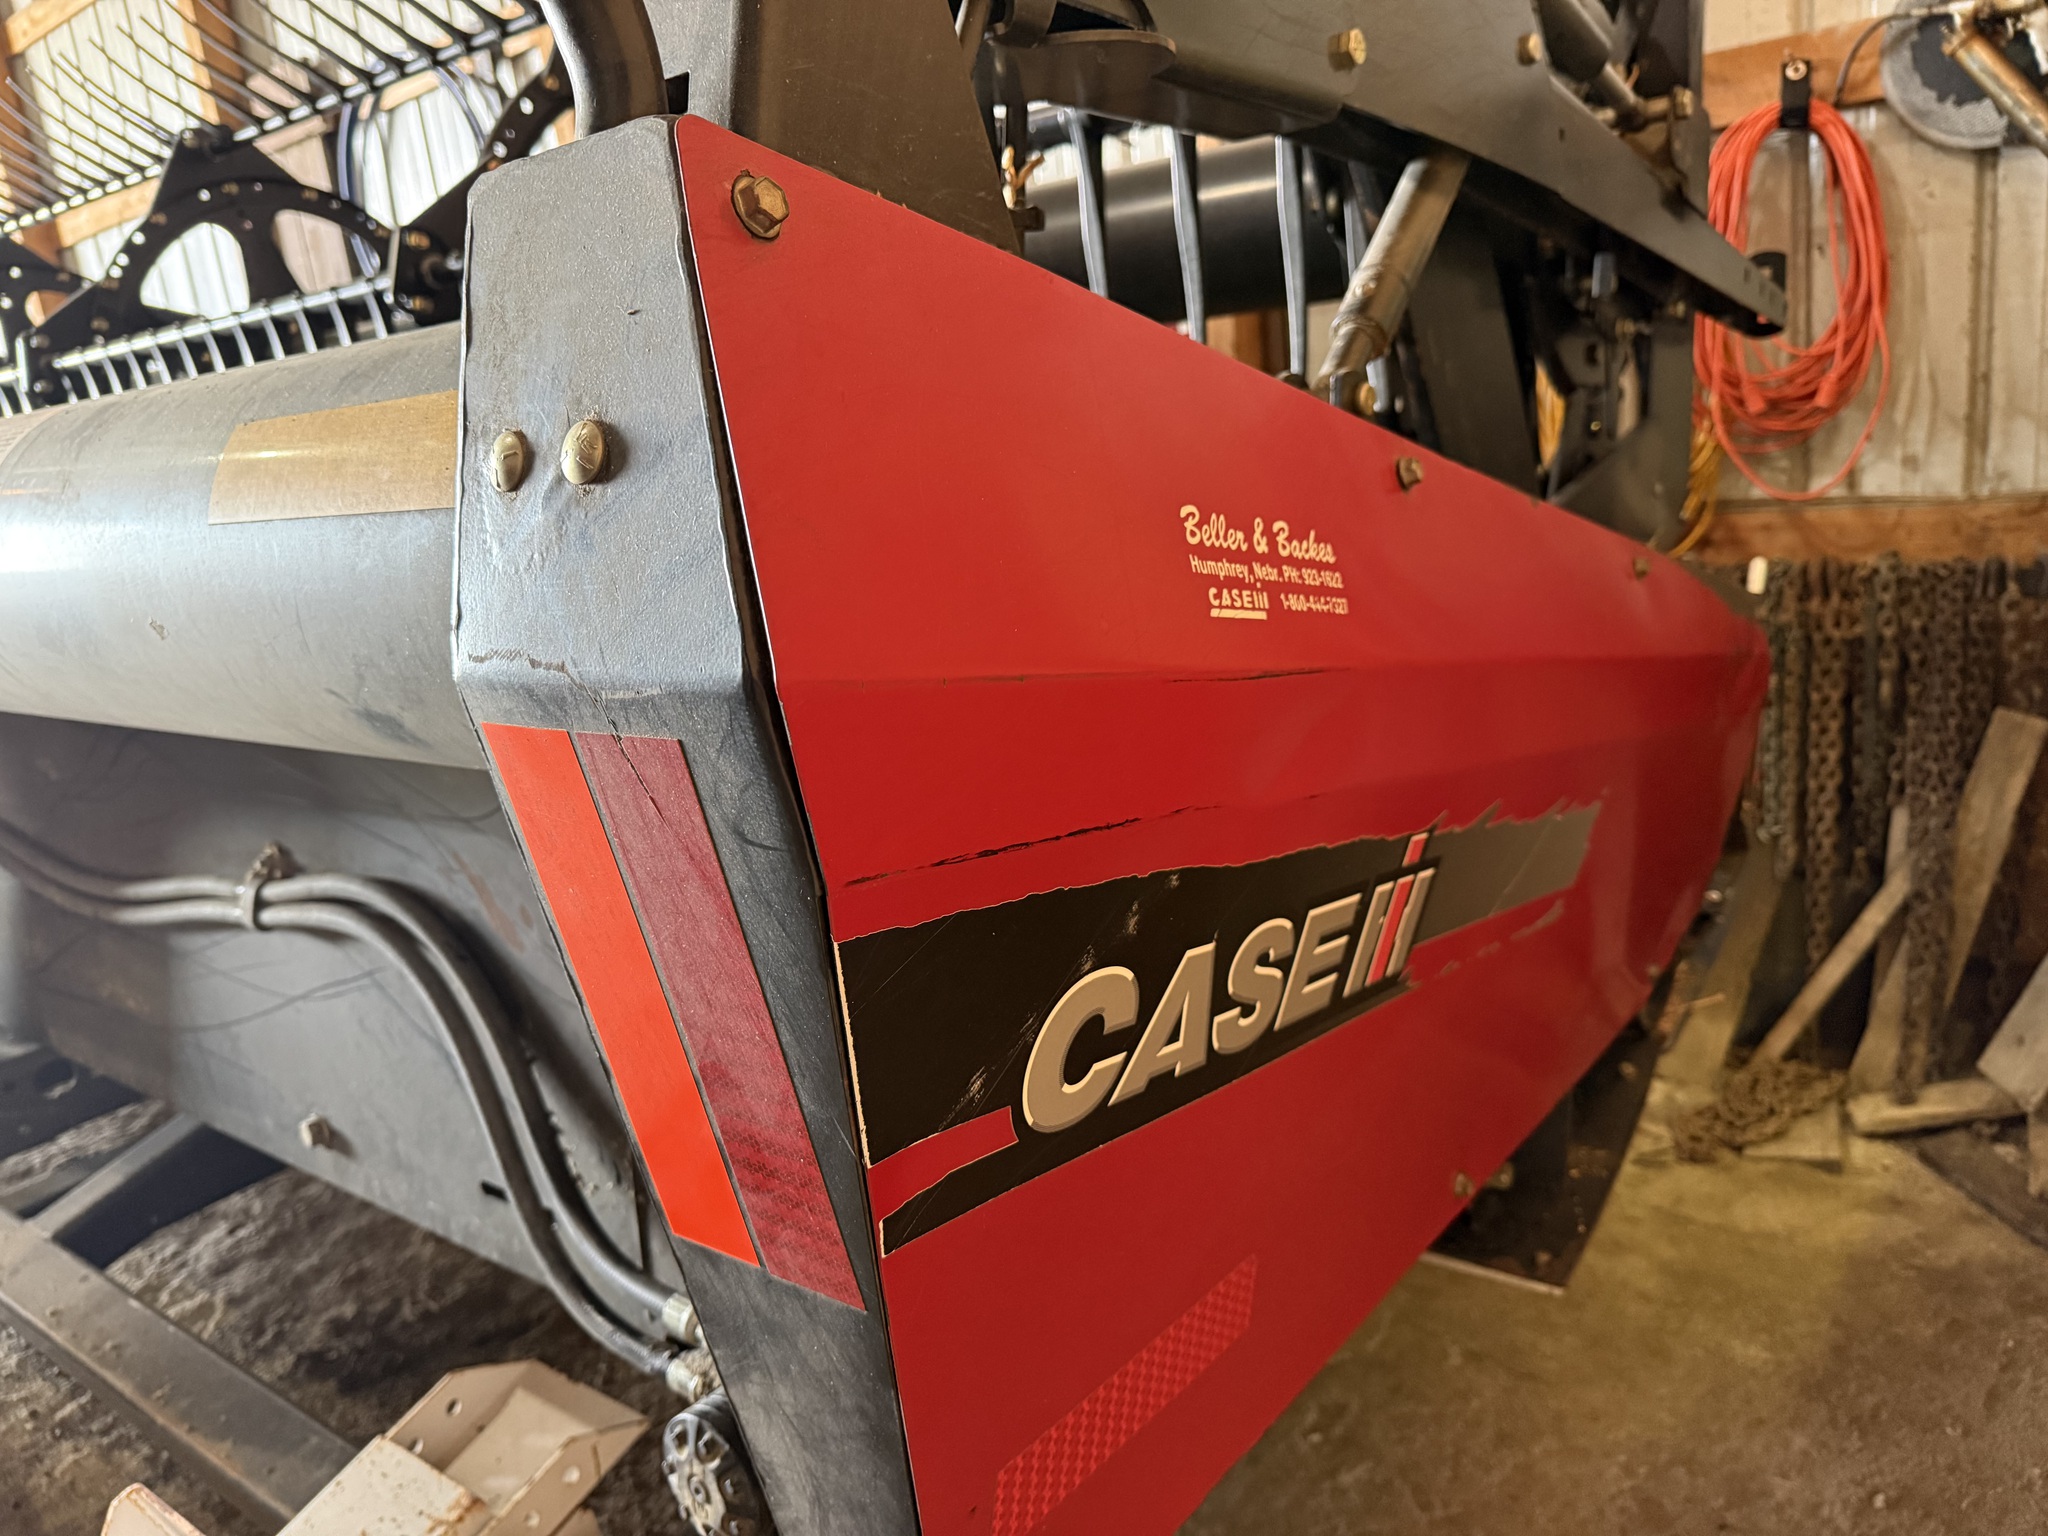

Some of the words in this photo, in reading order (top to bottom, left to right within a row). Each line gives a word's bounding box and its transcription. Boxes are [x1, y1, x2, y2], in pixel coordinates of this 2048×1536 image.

[1180, 504, 1248, 551] Beller
[1253, 517, 1269, 554] &
[1272, 520, 1337, 564] Backes
[1188, 554, 1254, 583] Humphrey,
[1252, 562, 1283, 582] Nebr.
[1282, 565, 1302, 584] PH:
